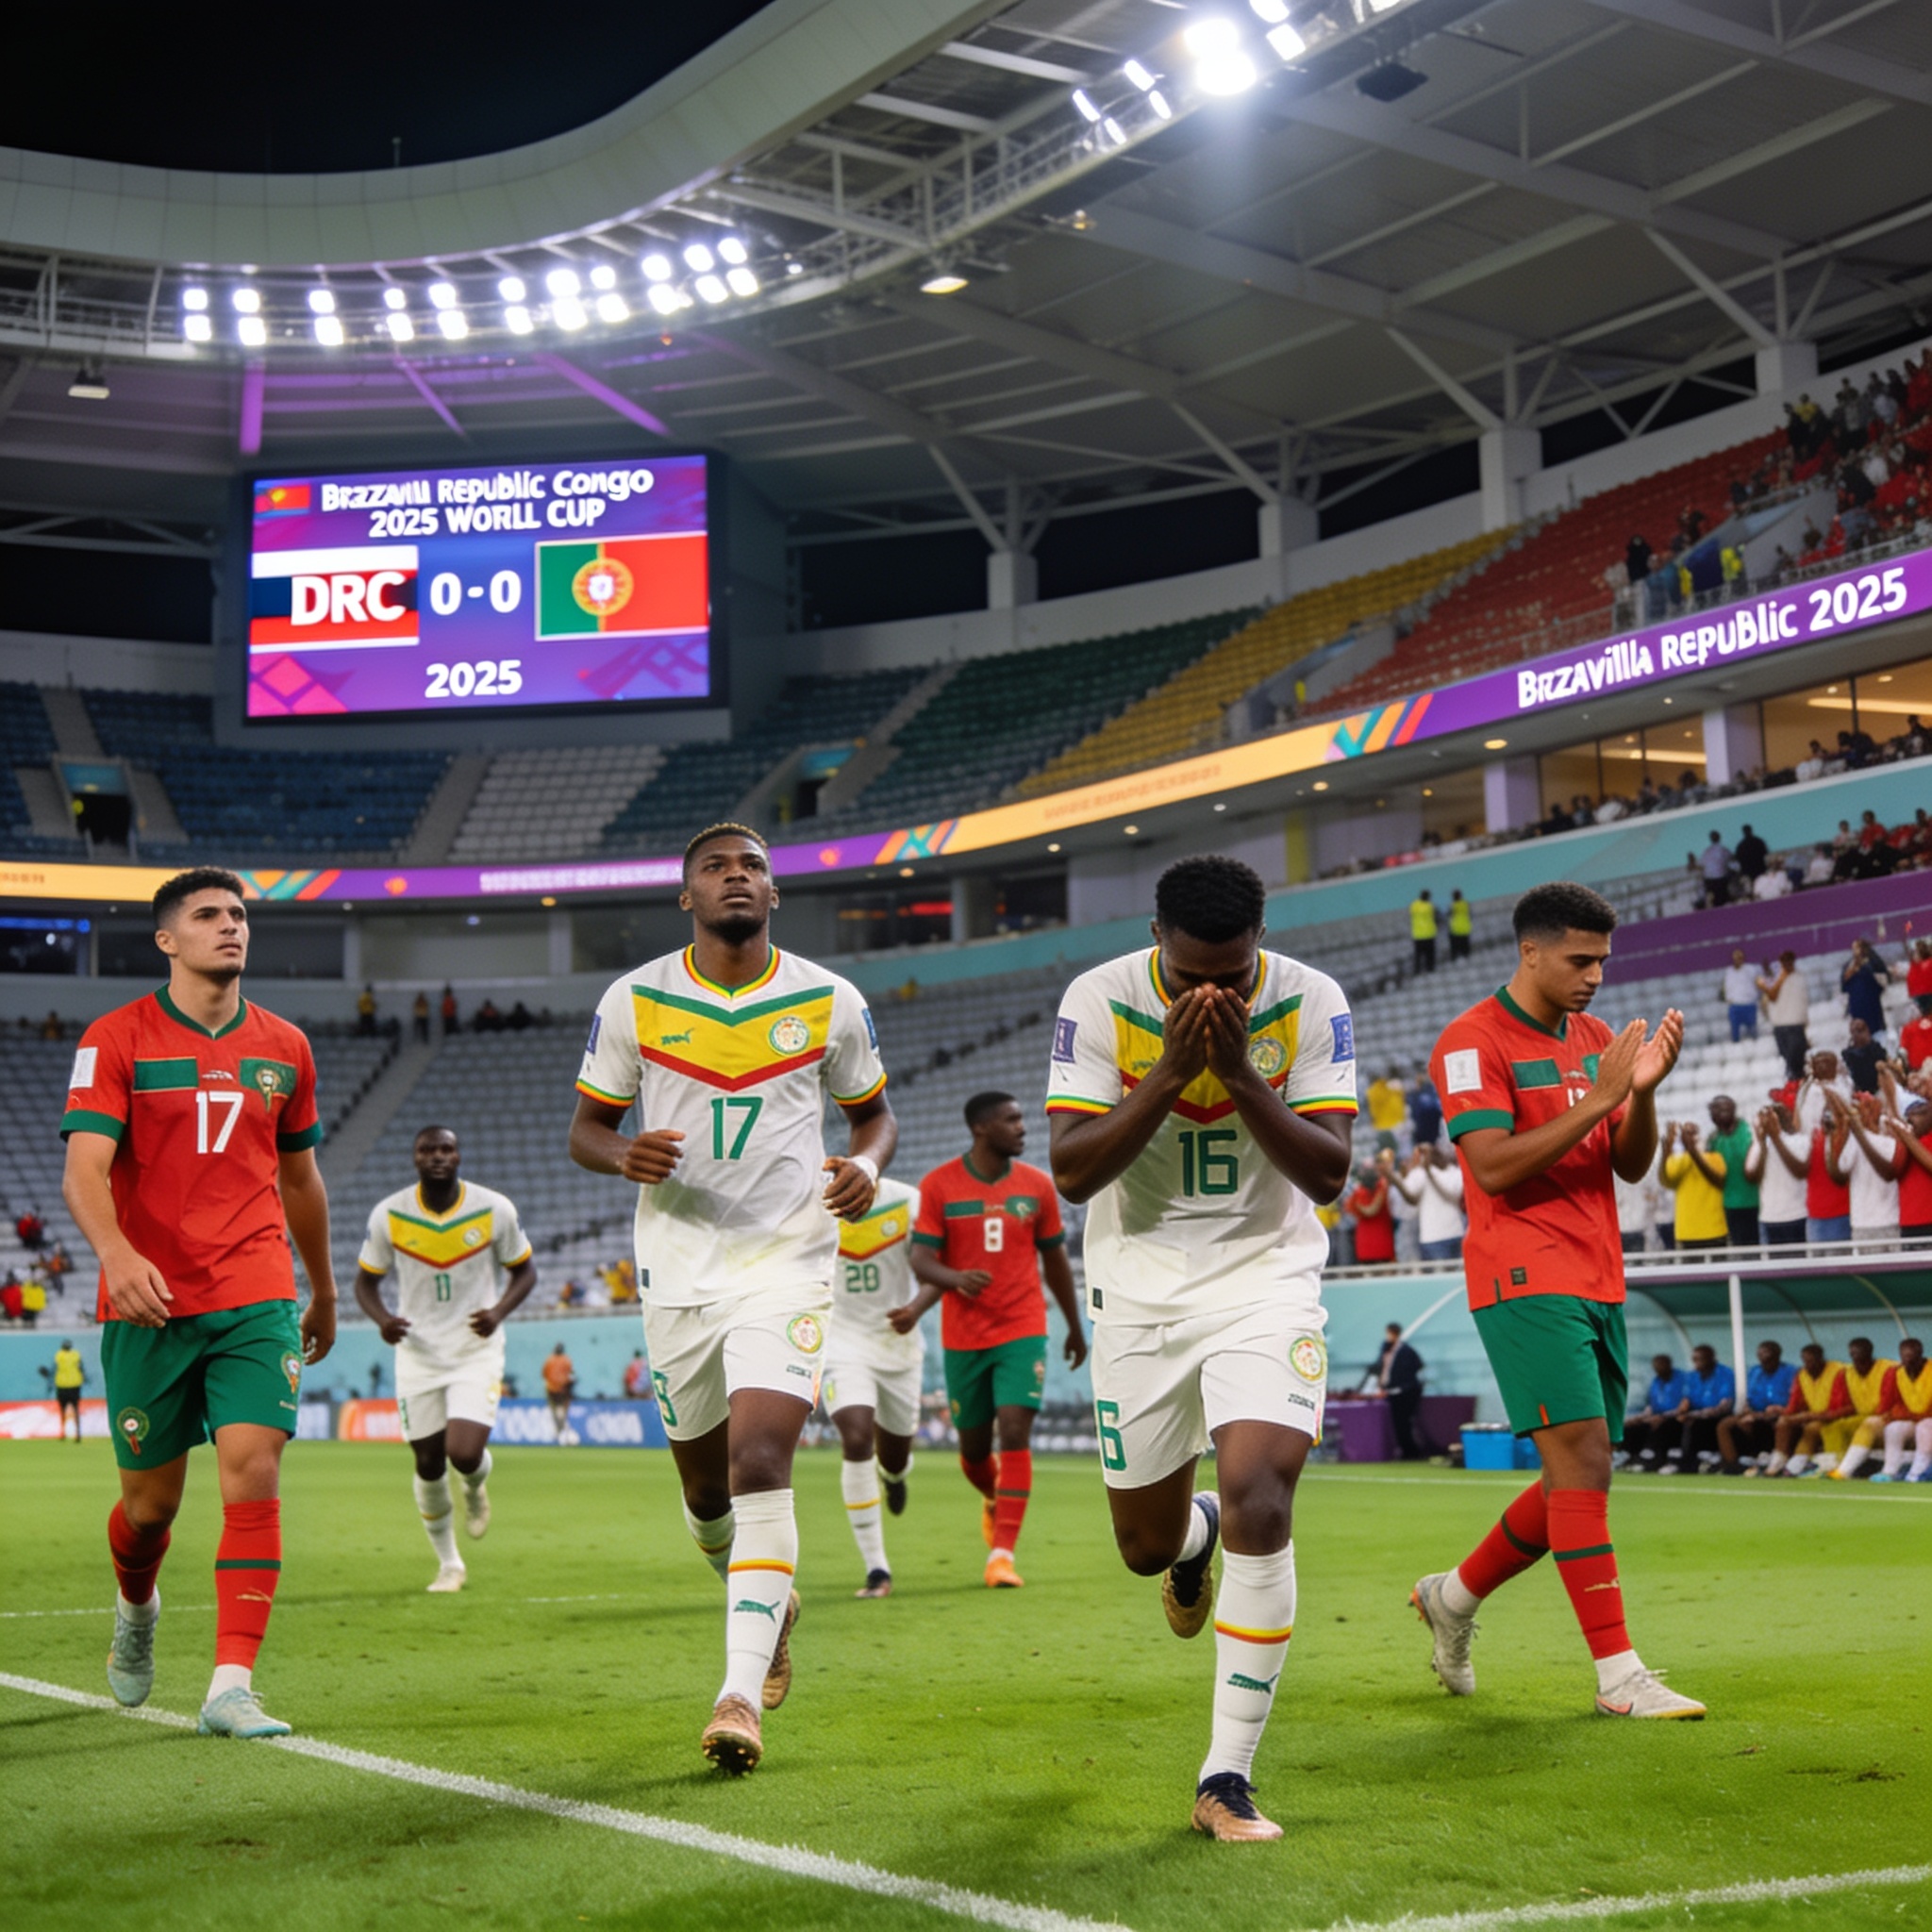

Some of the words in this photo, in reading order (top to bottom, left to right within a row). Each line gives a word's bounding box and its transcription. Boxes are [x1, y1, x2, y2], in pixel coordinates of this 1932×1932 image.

[552, 469, 655, 502] Congo
[369, 507, 440, 538] 2025
[547, 497, 607, 527] CUP
[291, 571, 407, 625] DRC
[1808, 567, 1907, 631] 2025
[425, 660, 523, 698] 2025
[195, 1091, 244, 1154] 17
[710, 1096, 763, 1160] 17
[1178, 1129, 1239, 1197] 16
[984, 1217, 1003, 1252] 8
